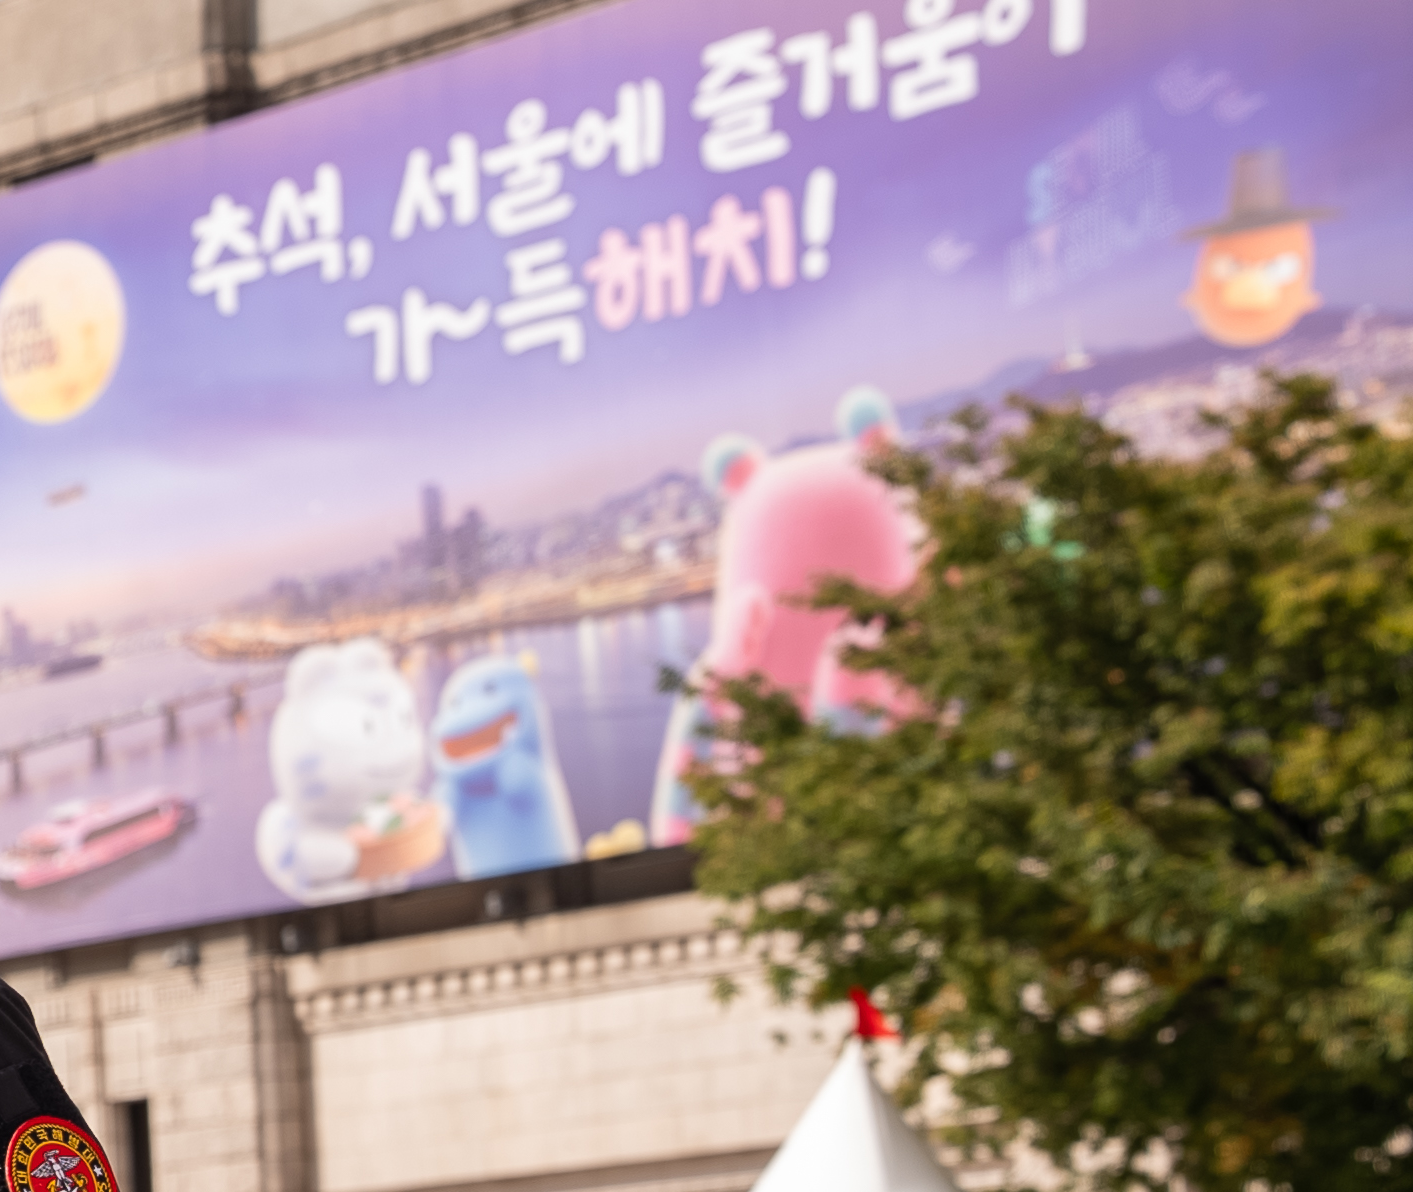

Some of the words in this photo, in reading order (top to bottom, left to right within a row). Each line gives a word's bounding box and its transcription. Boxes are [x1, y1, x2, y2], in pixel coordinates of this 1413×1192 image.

[188, 162, 373, 317] 추석,
[391, 78, 665, 240] 서울에
[690, 0, 1087, 173] 즐거움이
